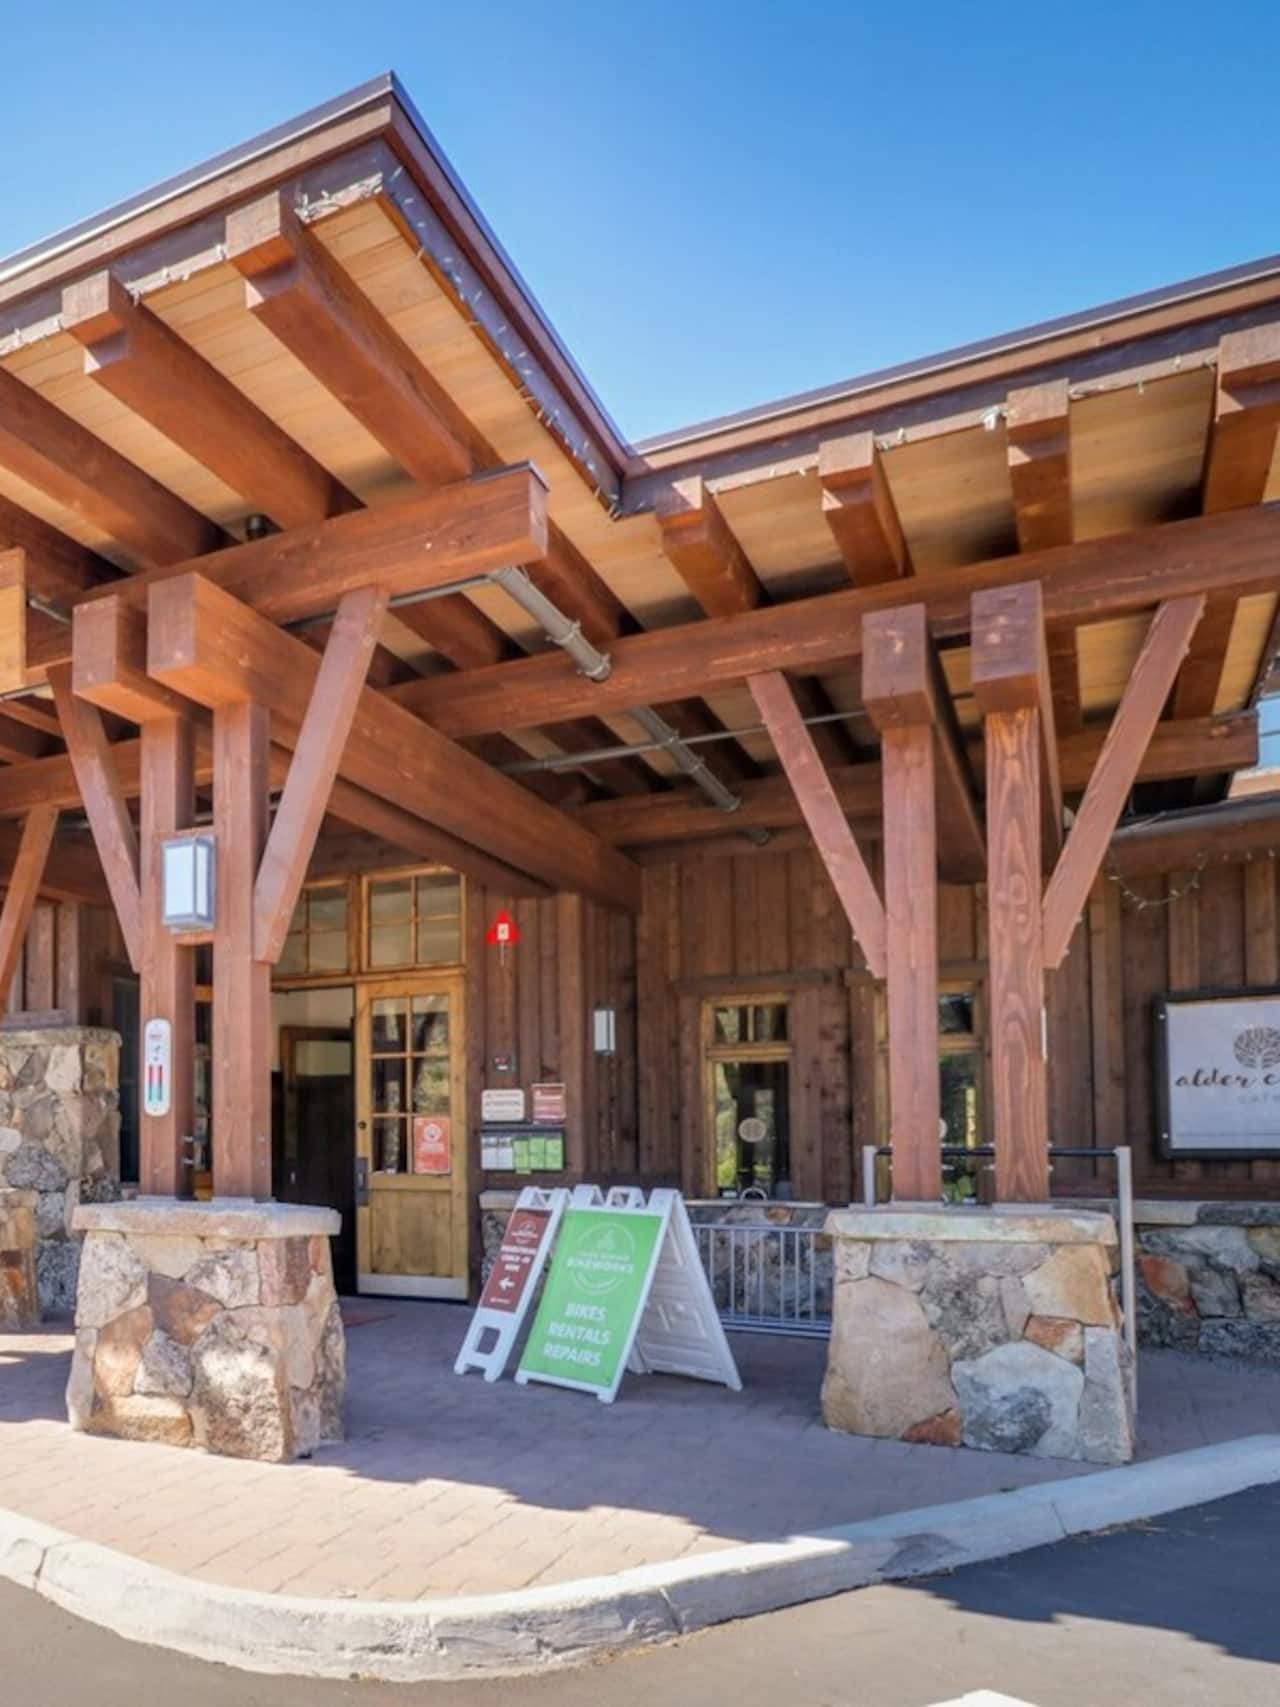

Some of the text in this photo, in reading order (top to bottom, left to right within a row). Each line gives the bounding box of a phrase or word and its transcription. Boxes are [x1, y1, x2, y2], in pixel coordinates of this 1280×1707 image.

[1175, 1067, 1252, 1088] alder
[564, 1302, 607, 1322] BIKES
[548, 1321, 612, 1346] RENTALS
[543, 1342, 601, 1368] REPAIRS
